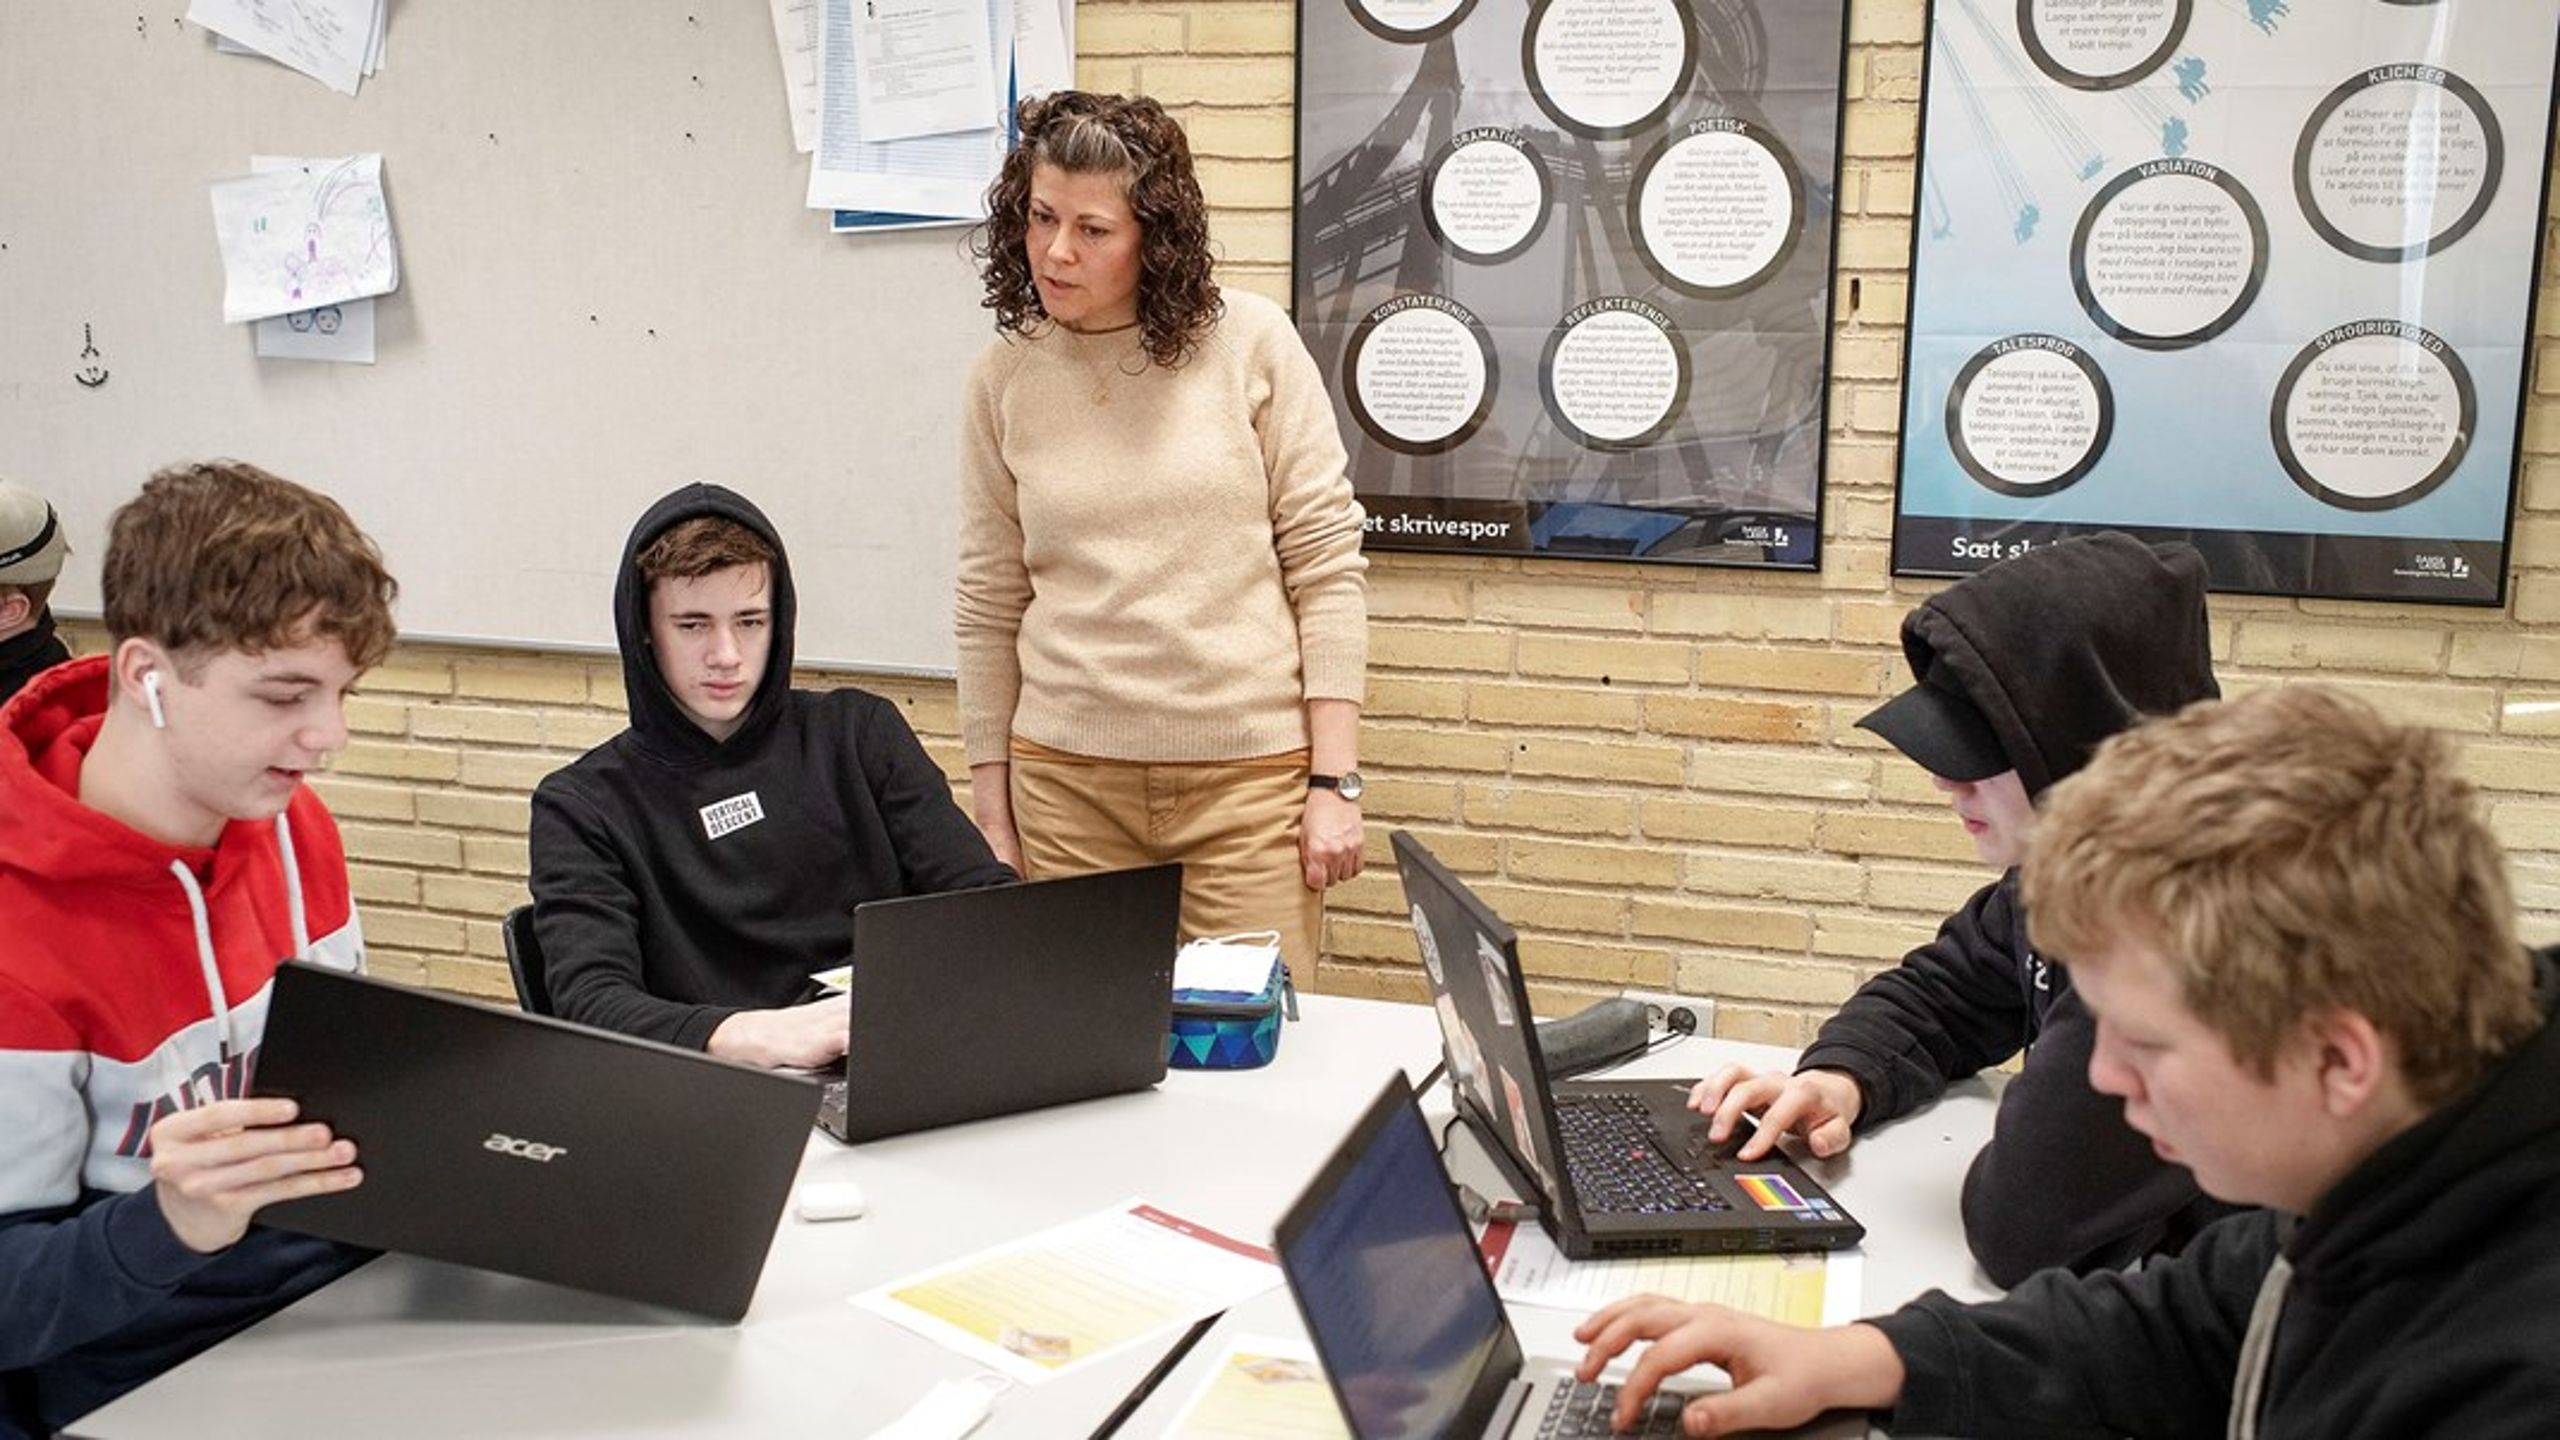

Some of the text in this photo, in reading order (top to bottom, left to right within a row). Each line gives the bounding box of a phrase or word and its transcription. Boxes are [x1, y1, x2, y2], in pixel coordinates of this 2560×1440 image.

[2045, 11, 2163, 24] Lange sætninger giver
[2072, 27, 2101, 35] mere
[2367, 65, 2446, 85] KLICHEER
[2343, 108, 2389, 119] Klicheer
[1689, 118, 1747, 134] POETISK
[2442, 122, 2460, 132] ved
[1451, 127, 1526, 149] DRAMATISK
[2337, 136, 2391, 147] formulere
[2137, 160, 2219, 180] VARIATION
[2320, 165, 2346, 176] Livet
[2454, 165, 2475, 176] kan
[2119, 201, 2227, 216] Varier din sætnings-
[2170, 215, 2188, 225] ved
[2133, 229, 2174, 240] leddene
[2098, 242, 2153, 255] Sætningen
[2157, 242, 2174, 256] Jeg
[2098, 256, 2121, 266] med
[2124, 256, 2166, 266] Frederik
[2218, 257, 2238, 267] kan
[2162, 284, 2184, 294] med
[1371, 295, 1476, 326] KONSTATERENDE
[1565, 299, 1672, 331] REFLEKTERENDE
[2315, 320, 2444, 353] SPROGRIGTIGHED
[1992, 336, 2076, 357] TALESPROG
[1987, 368, 2082, 381] Talesprog skal kun
[2334, 362, 2356, 372] skal
[2359, 363, 2383, 376] vise,
[2418, 363, 2439, 374] kan
[1986, 381, 2033, 391] anvendes
[2321, 375, 2354, 389] bruge
[2356, 376, 2396, 386] korrekt
[1978, 394, 2001, 404] hvor
[2003, 395, 2020, 405] det
[2307, 388, 2352, 402] sætning.
[2421, 391, 2441, 401] har
[1975, 407, 2006, 417] Oftest
[2310, 402, 2327, 413] sat
[2329, 403, 2349, 413] alle
[2351, 403, 2376, 417] tegn
[2061, 423, 2090, 433] andre
[2296, 415, 2340, 429] komma,
[2069, 436, 2087, 445] det
[2321, 443, 2340, 454] har
[2342, 444, 2358, 454] sat
[2361, 444, 2386, 455] dem
[2388, 445, 2431, 456] korrekt.
[1390, 514, 1511, 541] skrivespor
[1951, 537, 2002, 558] Sæt
[705, 797, 754, 821] VERTICAL
[710, 807, 758, 835] DESCENT
[483, 1133, 567, 1163] acer
